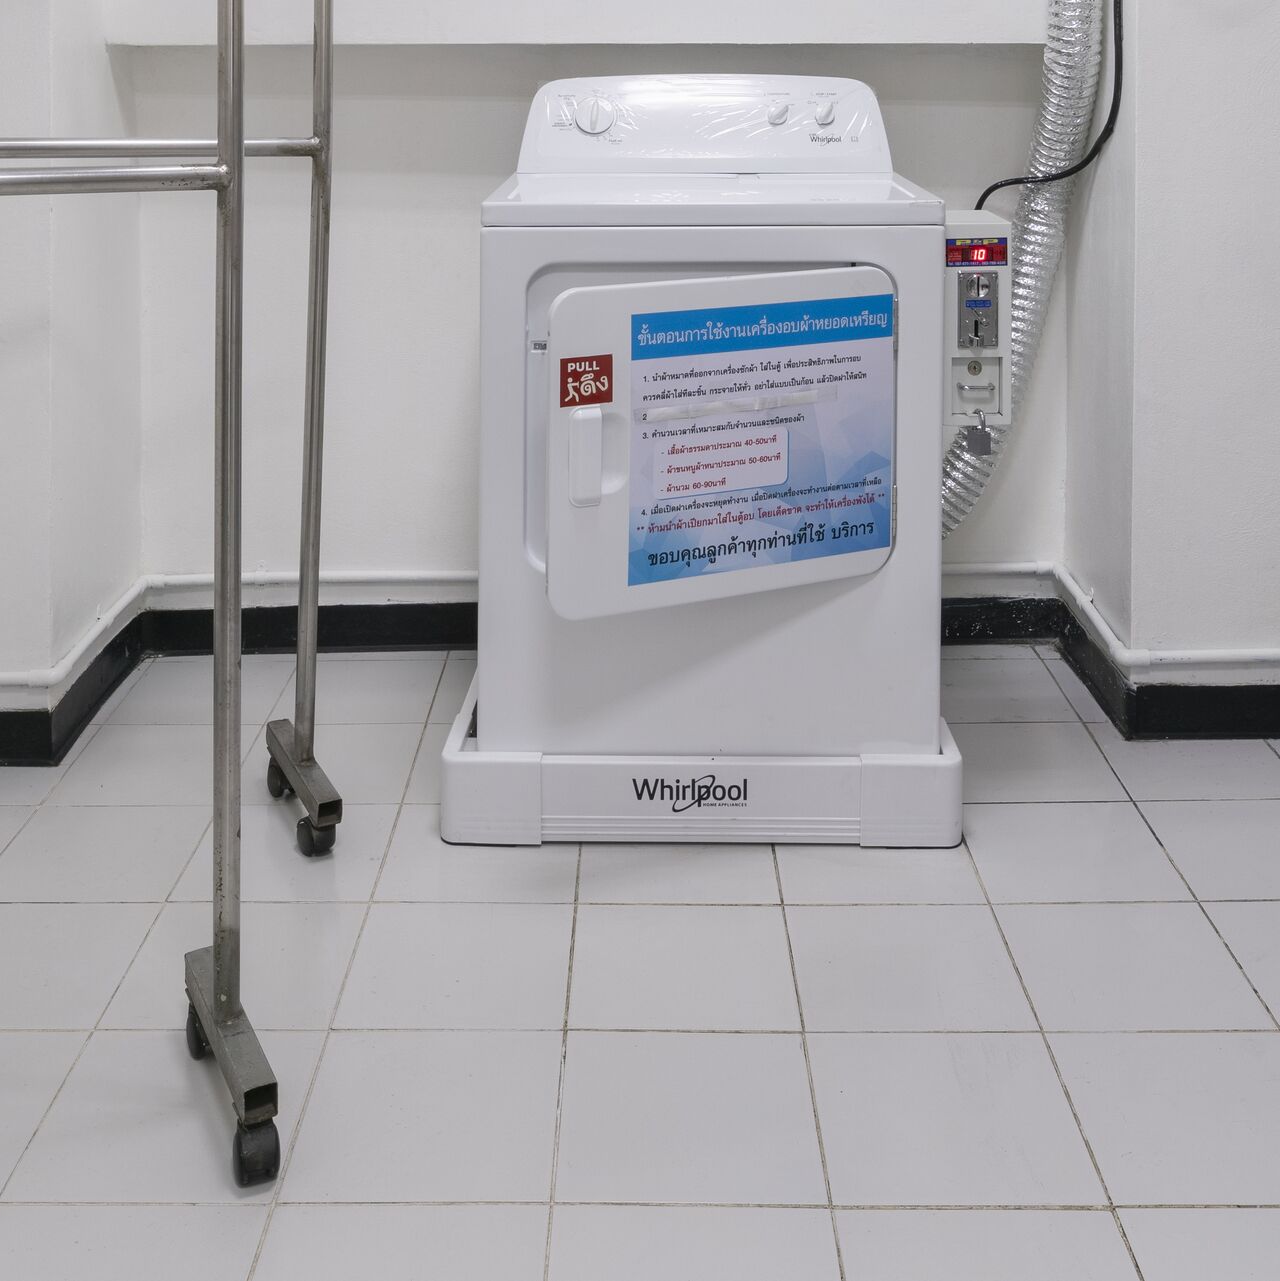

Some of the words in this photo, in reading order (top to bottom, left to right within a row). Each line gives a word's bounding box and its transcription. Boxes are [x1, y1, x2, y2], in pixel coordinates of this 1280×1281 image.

[809, 134, 841, 144] Whirlpool
[973, 249, 986, 260] 10
[637, 310, 888, 346] ขั้นตอนการใช้งานเครื่องอบผ้าหยอดเหรียญ
[568, 361, 600, 372] PULL
[580, 373, 608, 396] ดึง
[667, 441, 742, 456] เสื้อผ้าธรรมดาประมาณ
[745, 435, 776, 446] 40-50นาที
[749, 452, 781, 464] 50-60นาที
[667, 482, 690, 492] ผ้านวม
[693, 478, 726, 489] 60-90นาที
[648, 523, 826, 567] ขอบคุณลูกค้าทุกท่านที่ใช้
[832, 522, 874, 539] บริการ
[632, 777, 748, 809] Whirlpool
